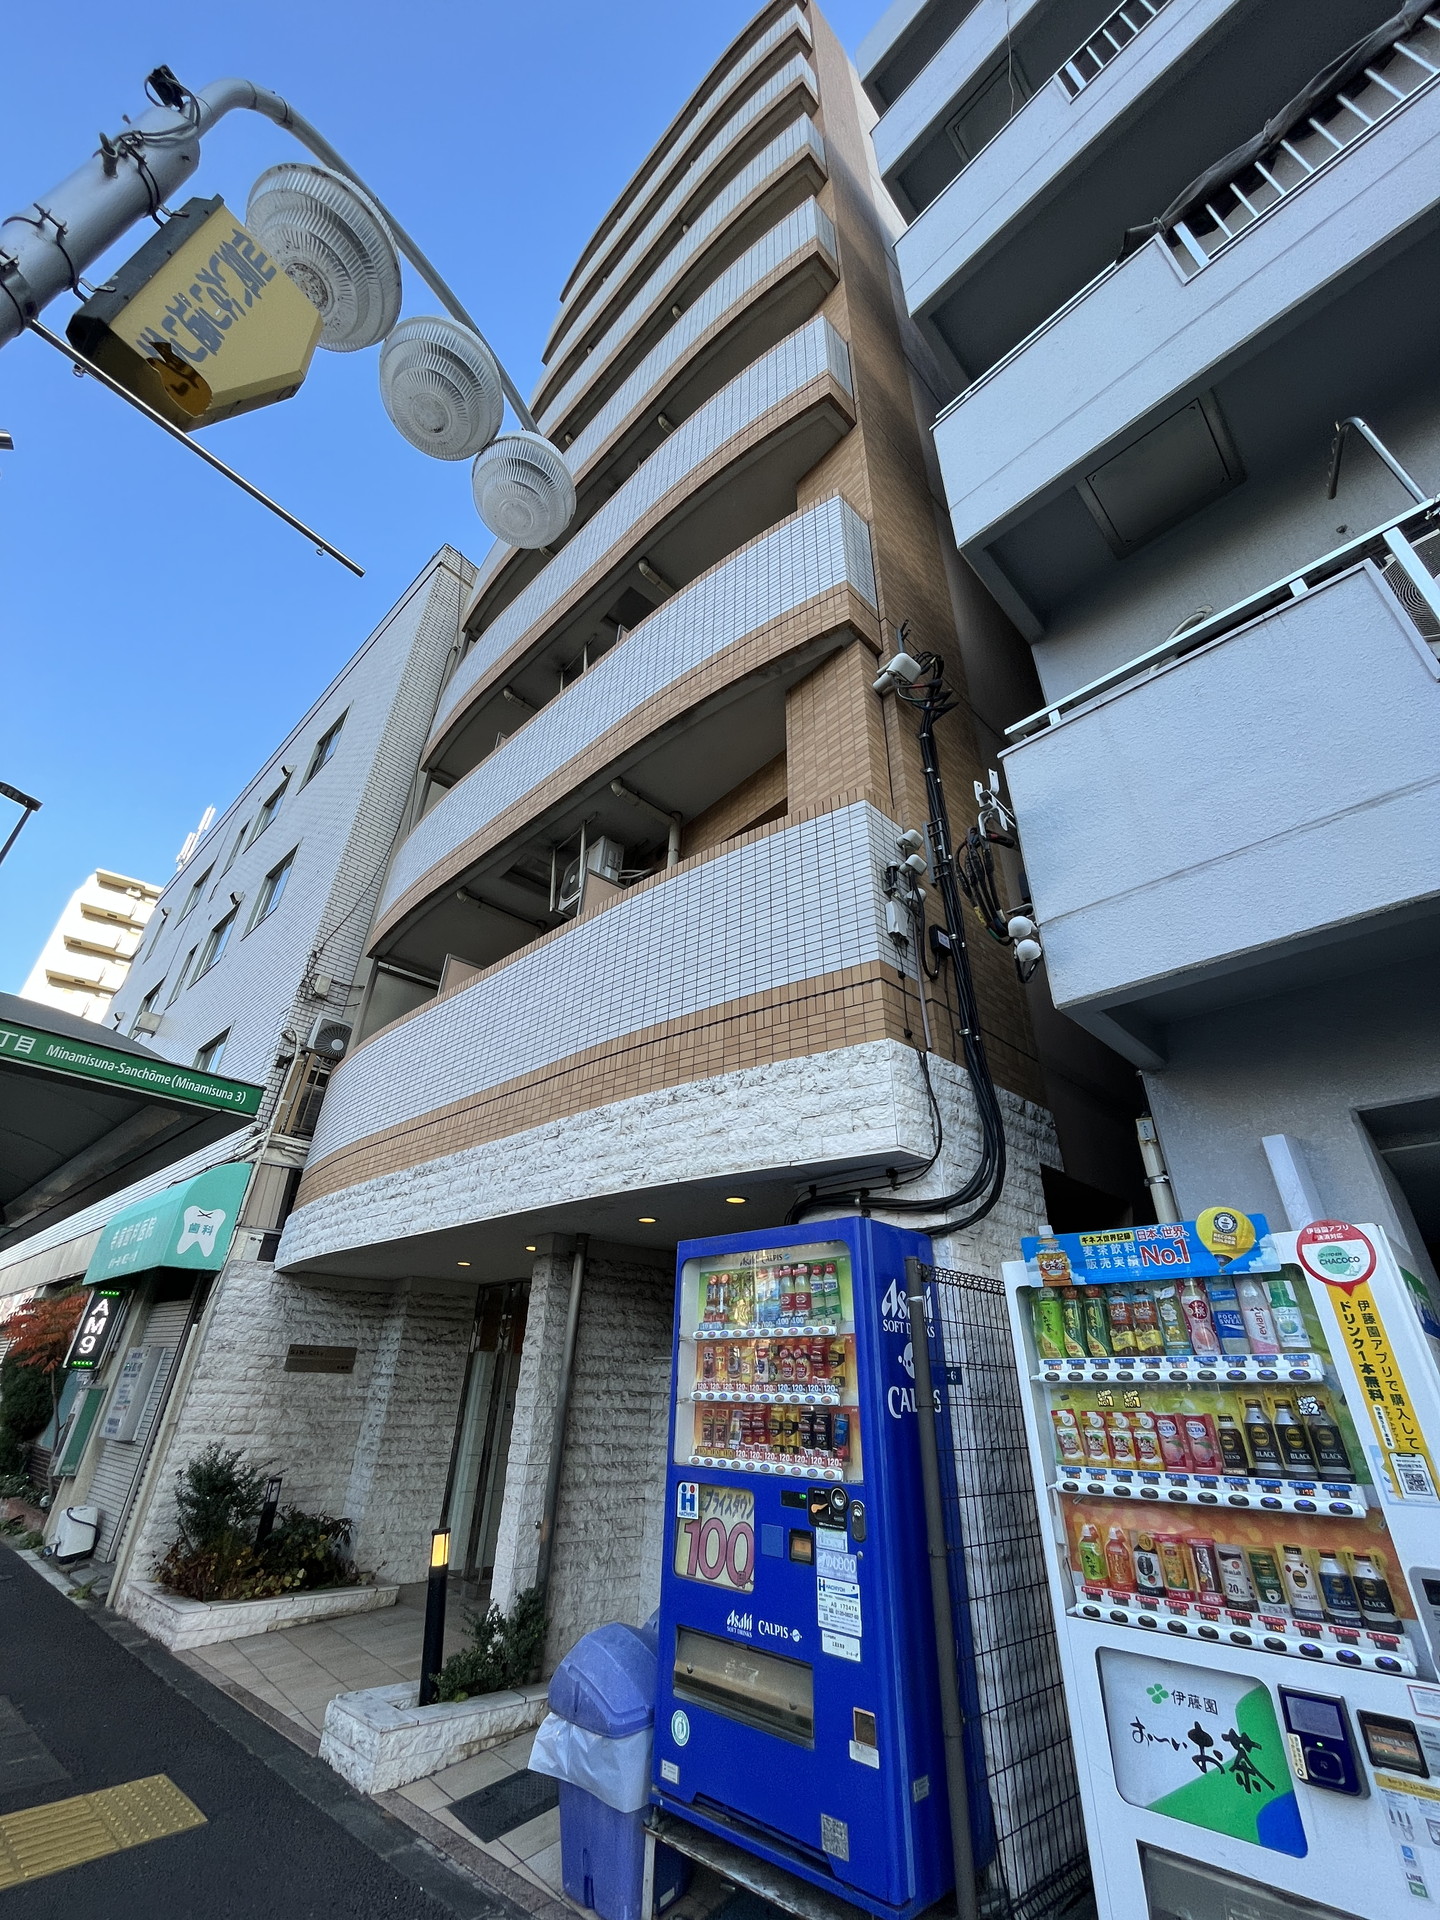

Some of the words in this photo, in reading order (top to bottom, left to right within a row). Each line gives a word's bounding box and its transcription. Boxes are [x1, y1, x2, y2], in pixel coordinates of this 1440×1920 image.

[0, 1030, 37, 1055] 丁目
[46, 1044, 171, 1086] Minamisuna-Sanchōme
[171, 1074, 233, 1101] (Minamisuna
[234, 1091, 247, 1105] 3)
[187, 1222, 214, 1236] 歯科
[1136, 1225, 1190, 1241] 日本、世界、
[1083, 1242, 1136, 1257] 麦茶飲料
[1140, 1238, 1191, 1267] No.1
[1086, 1255, 1142, 1269] 販売実績
[1319, 1256, 1361, 1266] CHACOCO
[883, 1319, 904, 1333] SOFT
[1254, 1312, 1268, 1336] evian
[1339, 1301, 1385, 1402] ドリンク1本無料
[888, 1385, 942, 1419] CALS
[1290, 1452, 1311, 1460] BLACK
[1320, 1452, 1343, 1460] BLACK
[684, 1517, 755, 1587] 100
[726, 1609, 753, 1631] Asahi
[758, 1620, 789, 1639] CALPIS
[1170, 1689, 1219, 1716] 伊藤園
